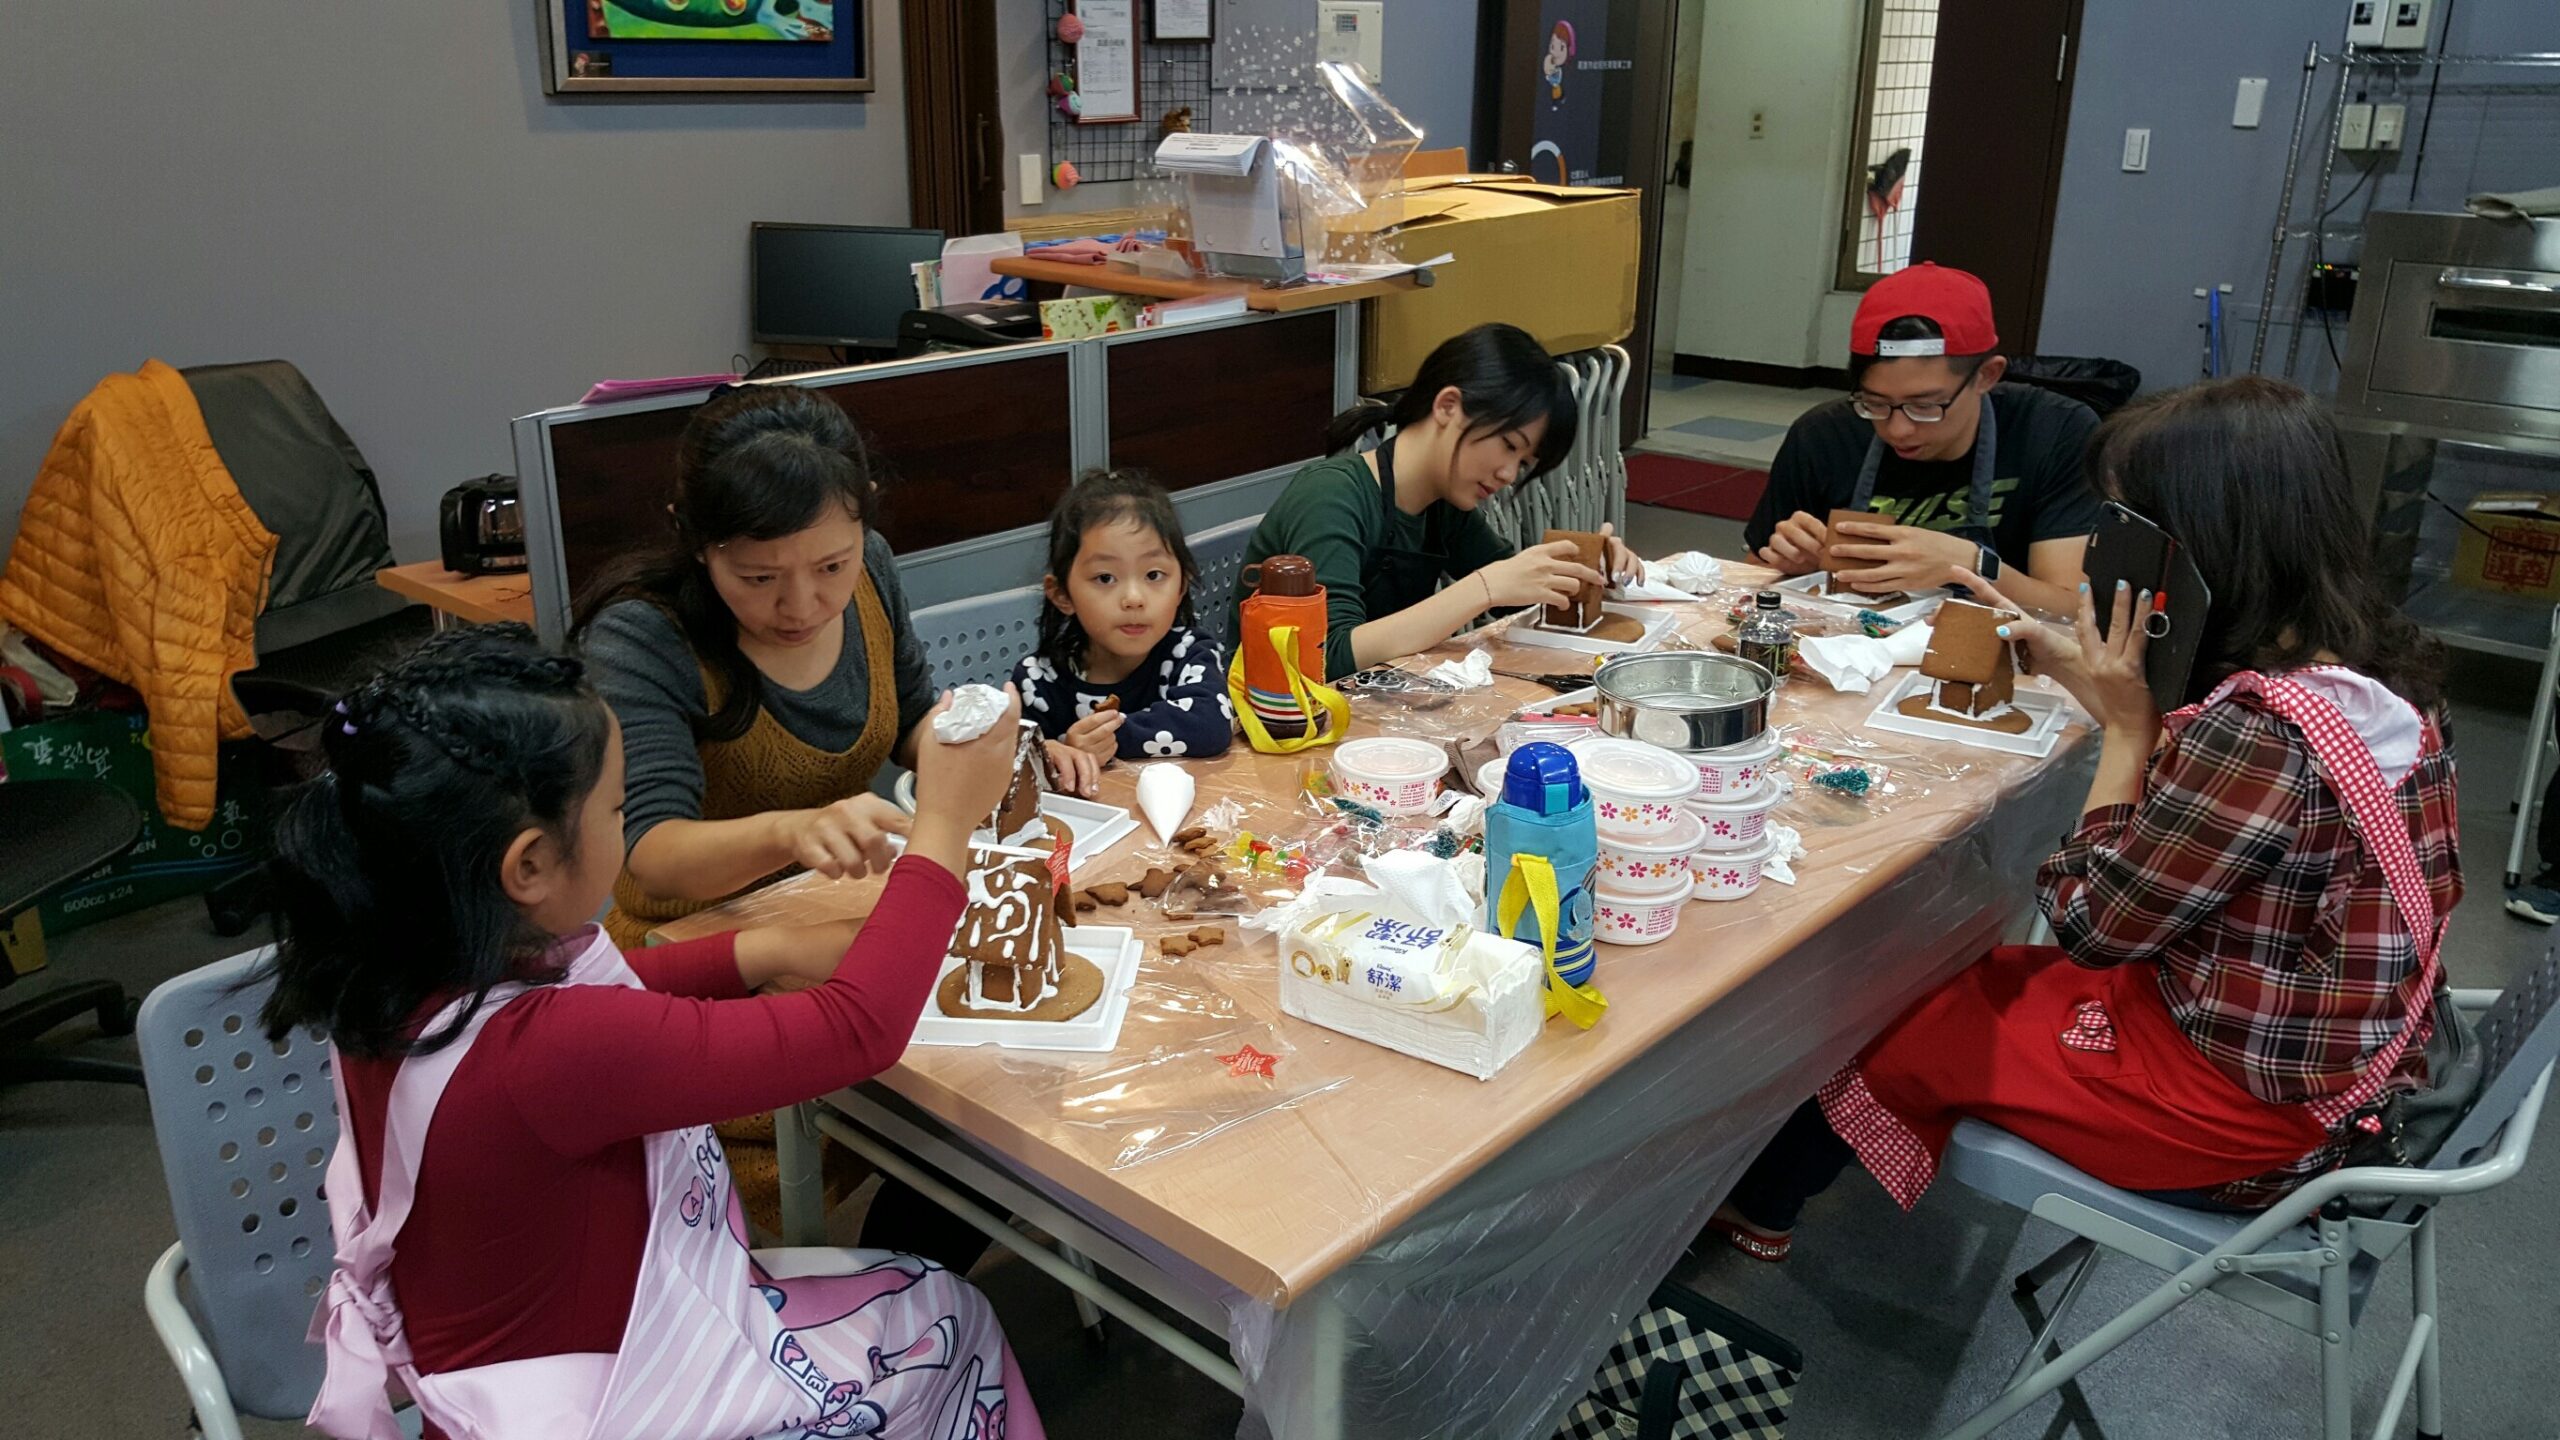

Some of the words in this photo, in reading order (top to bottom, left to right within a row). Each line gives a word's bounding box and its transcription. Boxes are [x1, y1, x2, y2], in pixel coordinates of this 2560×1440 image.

[63, 894, 106, 913] 600cc
[109, 884, 134, 902] x24
[1365, 918, 1444, 950] 舒潔
[1366, 967, 1403, 993] 舒潔
